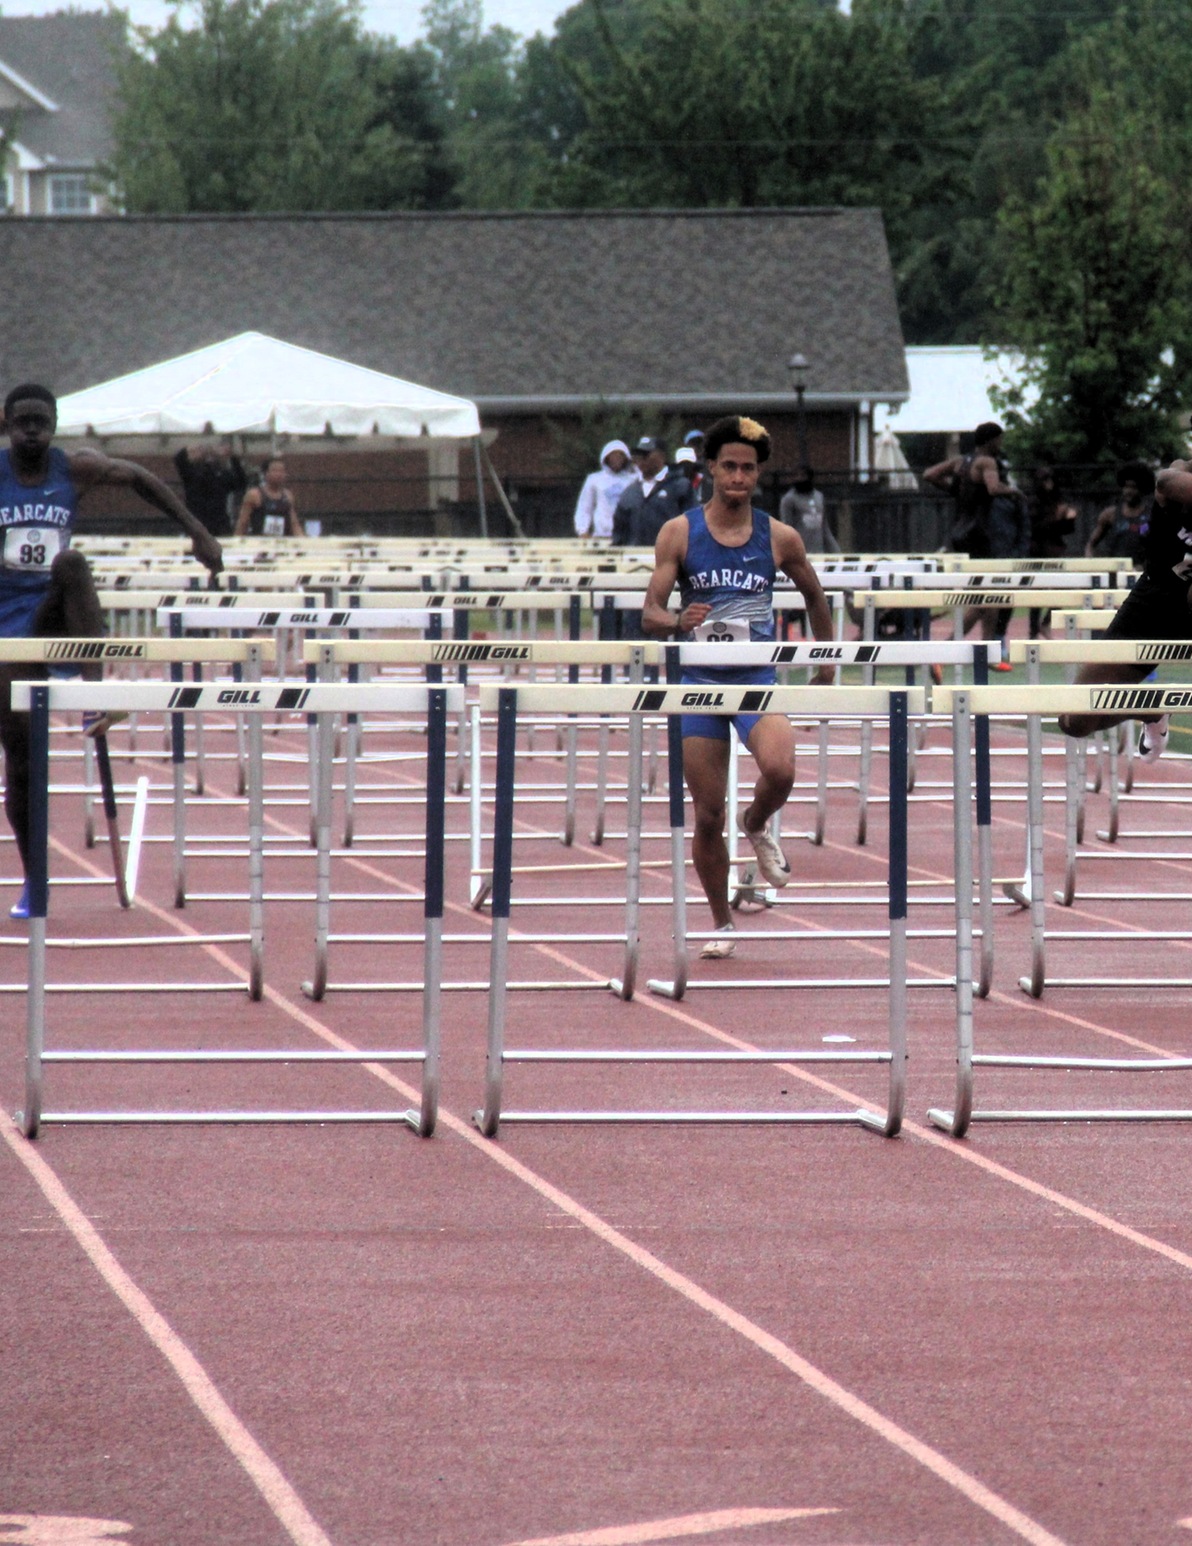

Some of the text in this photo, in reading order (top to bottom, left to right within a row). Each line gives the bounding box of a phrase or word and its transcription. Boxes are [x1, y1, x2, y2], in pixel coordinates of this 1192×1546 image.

[0, 504, 71, 526] EARCATS
[20, 544, 46, 564] 93
[186, 597, 209, 605] GILL
[453, 596, 477, 605] GILL
[984, 595, 1011, 604] GILL
[290, 613, 318, 623] GILL
[104, 644, 143, 657] GILL
[490, 647, 529, 659] GILL
[809, 648, 842, 658] GILL
[217, 690, 261, 703] GILL
[681, 692, 724, 706] GILL
